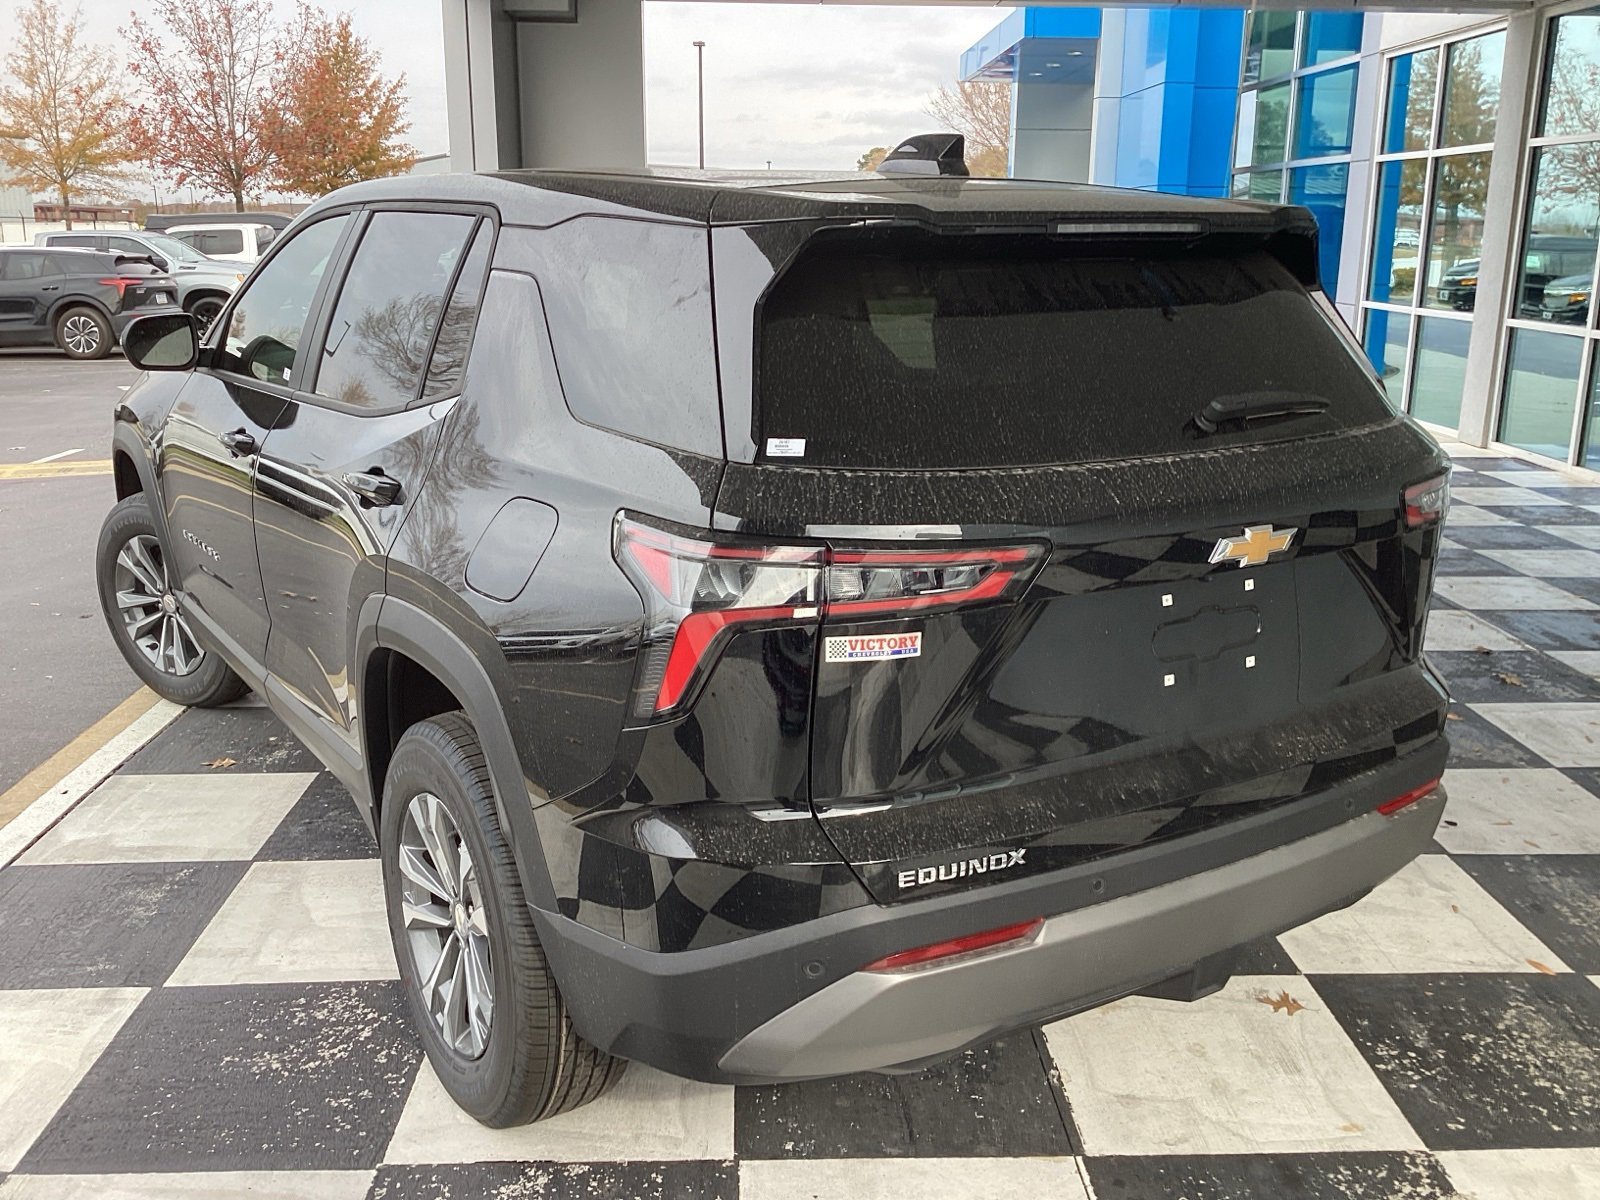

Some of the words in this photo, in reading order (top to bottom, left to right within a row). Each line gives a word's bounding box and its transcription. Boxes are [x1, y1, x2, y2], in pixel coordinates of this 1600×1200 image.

[848, 636, 919, 651] VICTORY
[852, 650, 893, 658] CHEVROLET
[898, 847, 1027, 888] EQUINOX
